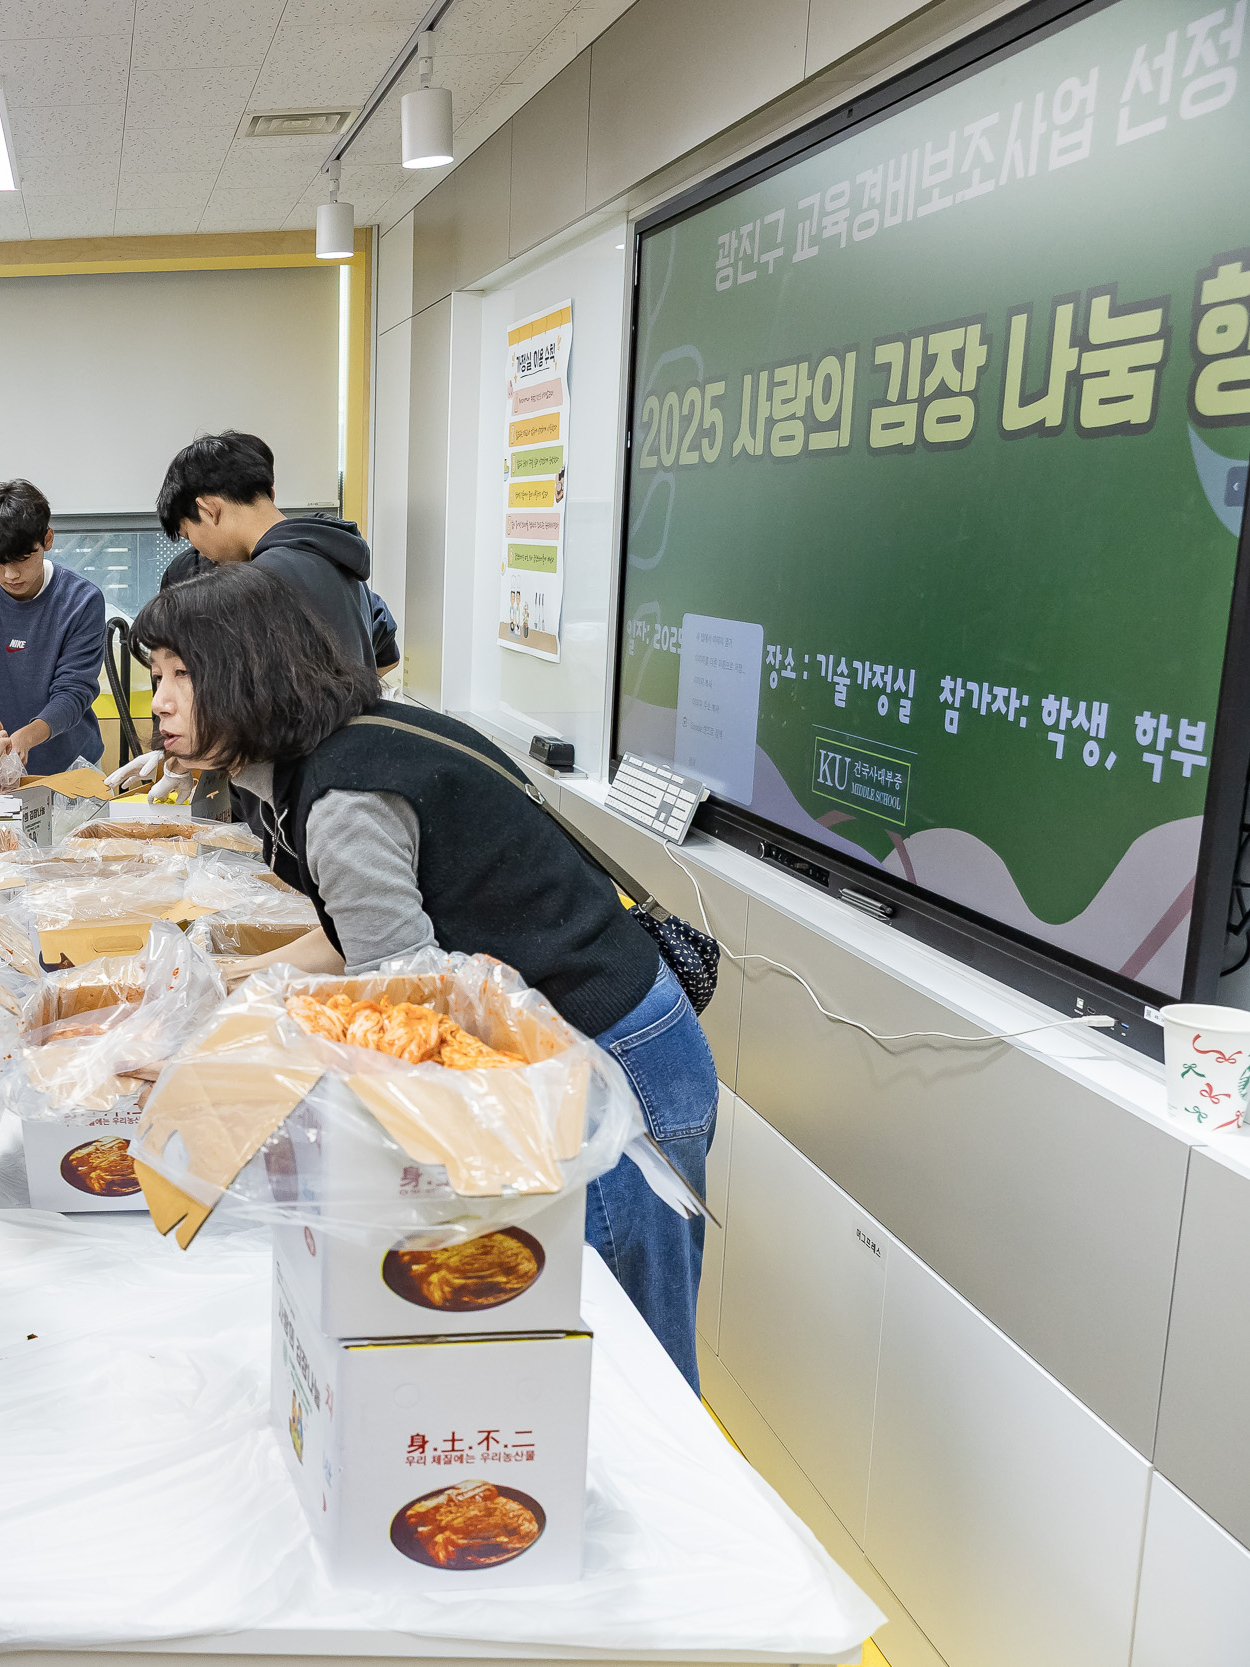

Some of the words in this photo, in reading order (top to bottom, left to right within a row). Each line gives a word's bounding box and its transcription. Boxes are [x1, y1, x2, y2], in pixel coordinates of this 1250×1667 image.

[715, 209, 785, 292] 광진구
[792, 65, 1100, 263] 교육경비보조사업
[1116, 0, 1247, 146] 선정
[639, 381, 726, 469] 2025
[732, 350, 857, 457] 사랑의
[869, 323, 988, 448] 김장
[1001, 295, 1165, 431] 나눔
[9, 639, 27, 649] NIKE
[765, 643, 797, 690] 장소
[816, 653, 917, 725] 기술가정실
[939, 675, 1029, 735] 참가자:
[1041, 694, 1117, 771] 학생,
[1135, 711, 1207, 783] 학부
[817, 749, 851, 791] KU
[853, 760, 903, 790] 건국사대부중
[851, 782, 875, 801] MIDDLE
[875, 790, 901, 810] SCHOOL
[405, 1455, 427, 1467] 우리
[431, 1453, 476, 1466] 체질에는
[480, 1450, 536, 1464] 우리농산물
